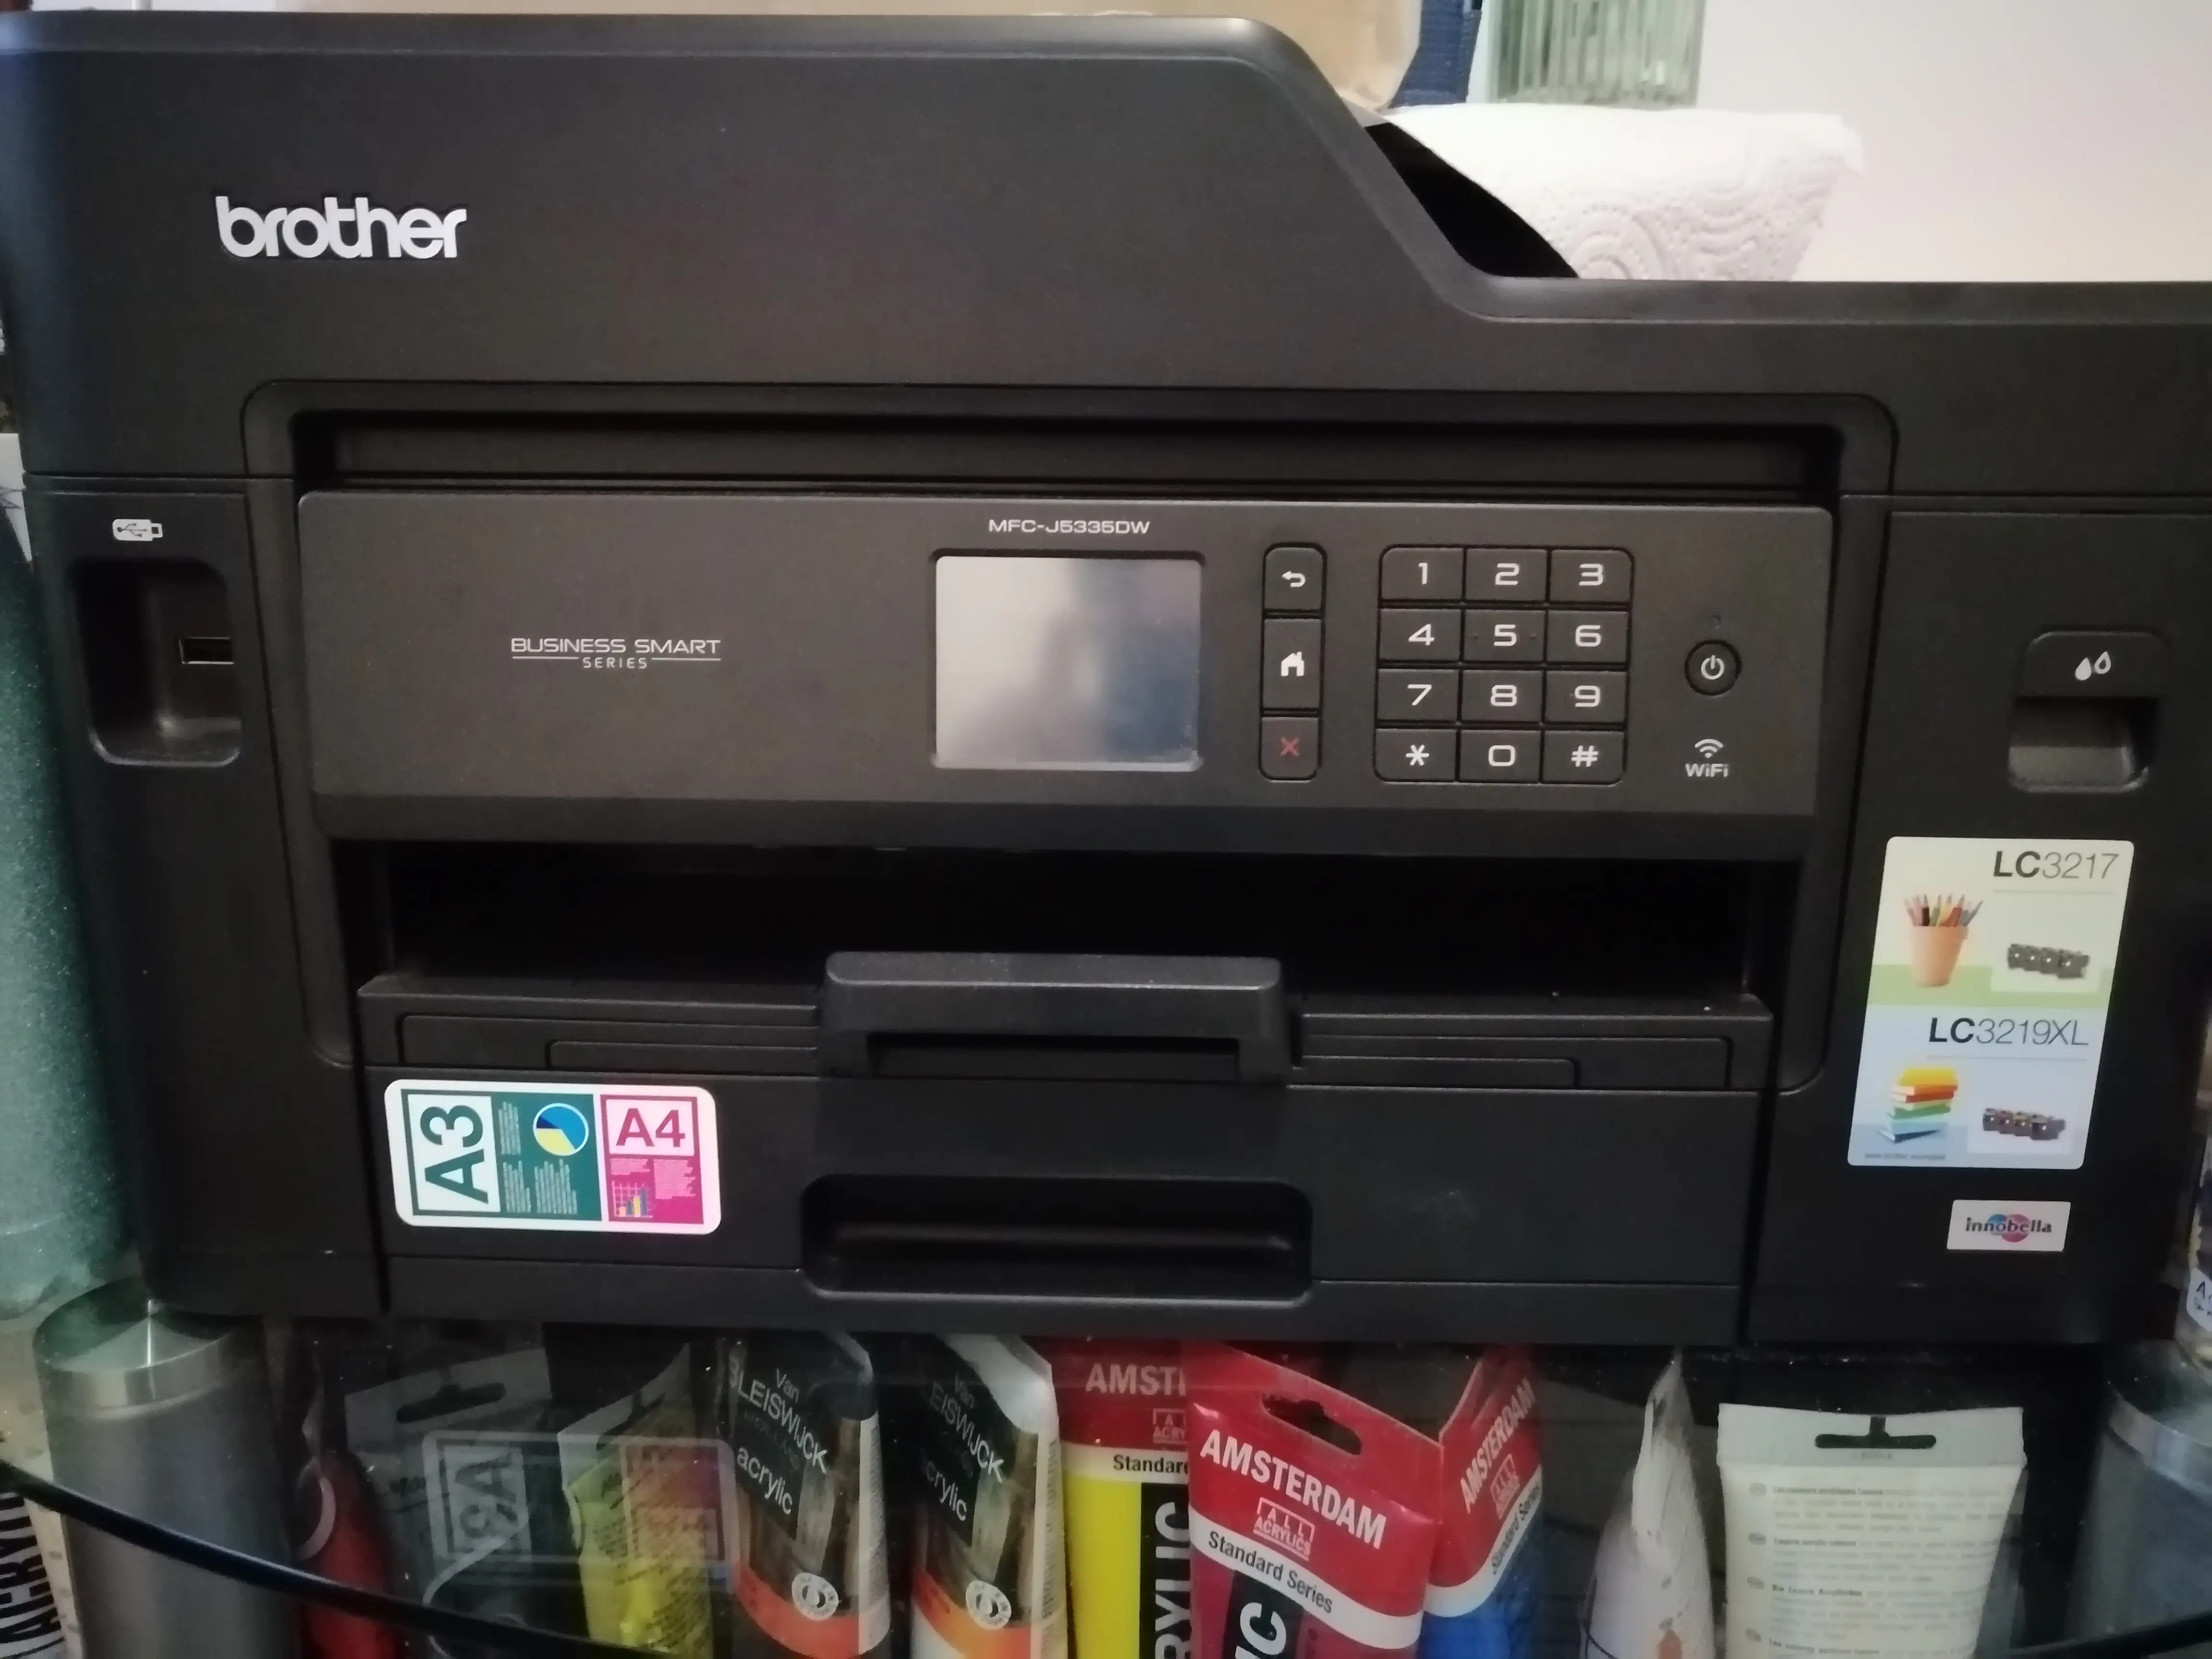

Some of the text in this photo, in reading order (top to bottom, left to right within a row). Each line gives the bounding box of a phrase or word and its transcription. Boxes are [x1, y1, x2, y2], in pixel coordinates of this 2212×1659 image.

[216, 196, 467, 259] brother
[989, 519, 1150, 533] MFC-J5335DW
[1418, 563, 1604, 586] 1 2 3
[511, 638, 721, 653] BUSINESS SMART
[1408, 624, 1601, 647] 4 5 6
[583, 657, 647, 669] SERIES
[1407, 684, 1600, 707] 7 8 9
[1571, 745, 1599, 767] #
[1685, 763, 1729, 777] WiFi
[1993, 851, 2118, 879] LC3217
[1929, 1018, 2090, 1046] LC3219XL
[616, 1108, 685, 1148] A4
[420, 1105, 489, 1204] A3
[1966, 1217, 2052, 1232] innobella
[776, 1369, 799, 1403] Van
[1460, 1377, 1536, 1515] AMSTERDAM
[737, 1448, 793, 1515] acrylic
[923, 1455, 967, 1521] crylic
[1200, 1430, 1386, 1550] AMSTERDAM
[1254, 1515, 1311, 1556] ACRYLICS
[1209, 1531, 1333, 1614] Standard Series
